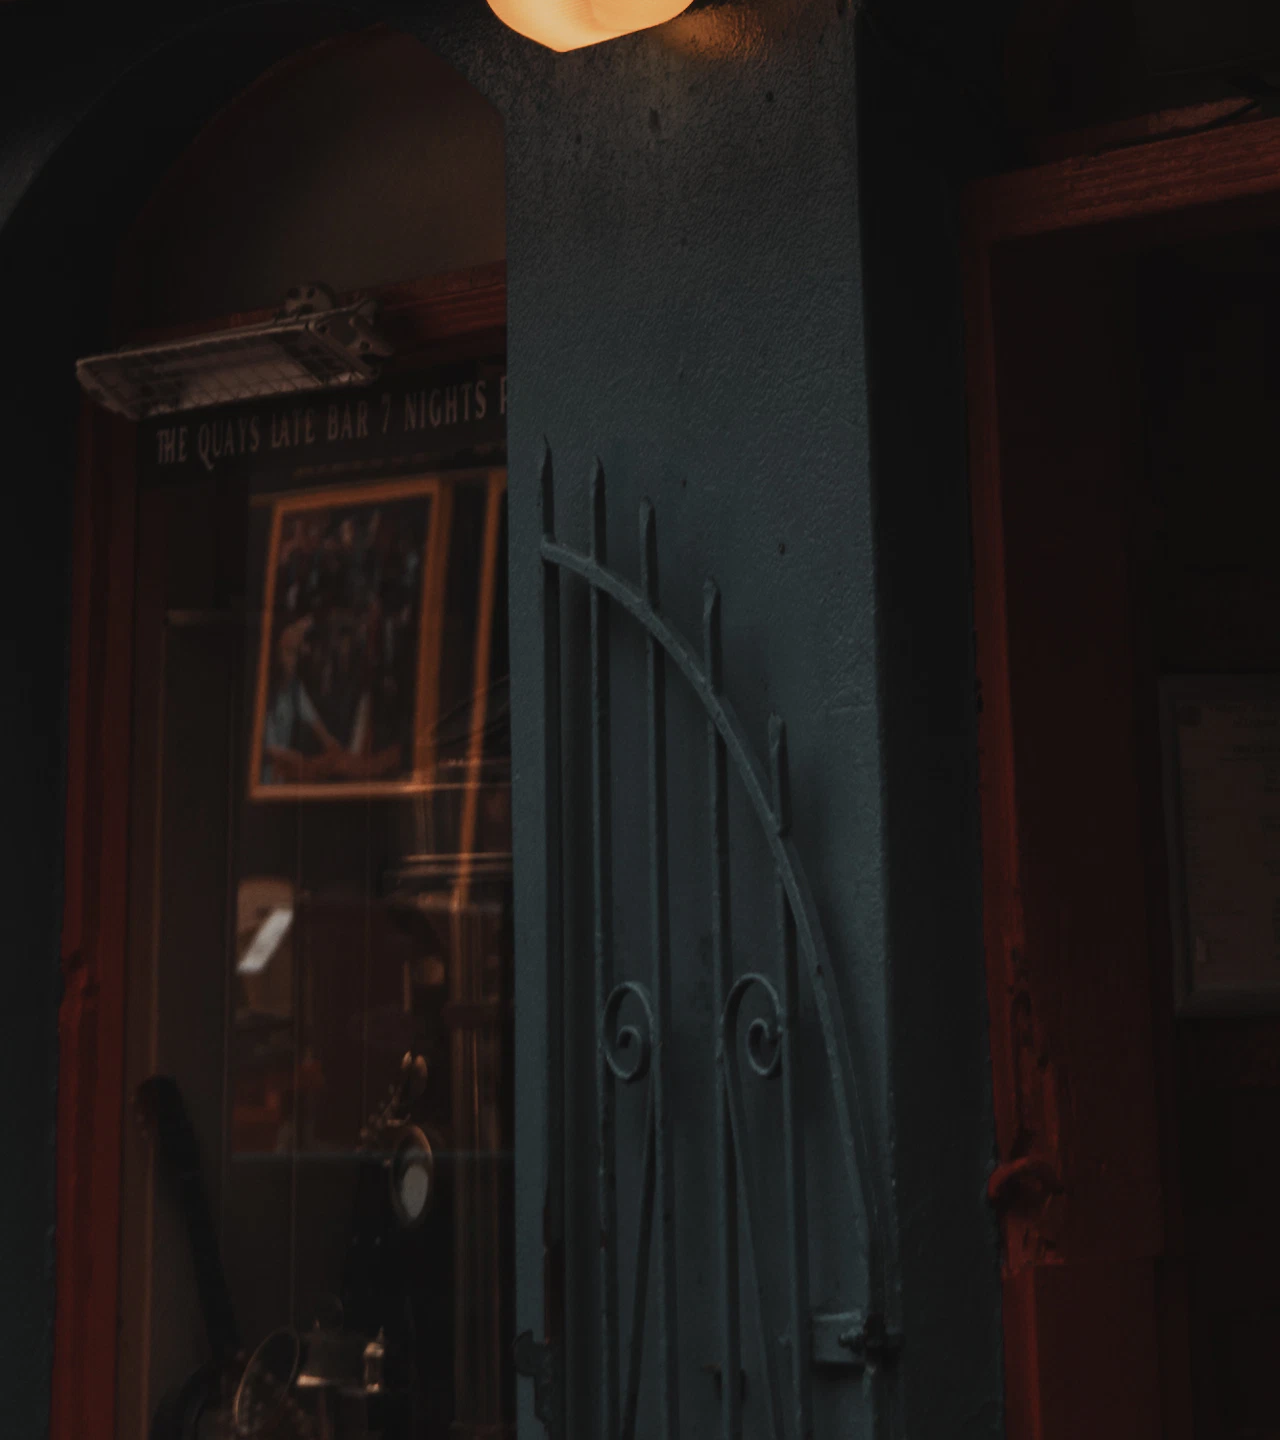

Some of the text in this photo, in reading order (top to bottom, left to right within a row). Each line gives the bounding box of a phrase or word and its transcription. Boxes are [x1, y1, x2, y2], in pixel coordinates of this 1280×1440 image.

[156, 423, 189, 466] THE
[197, 413, 261, 472] QUAYS
[270, 408, 317, 450] LATE
[326, 400, 369, 442] BAR
[380, 392, 393, 435] 7
[403, 378, 488, 433] NIGHTS
